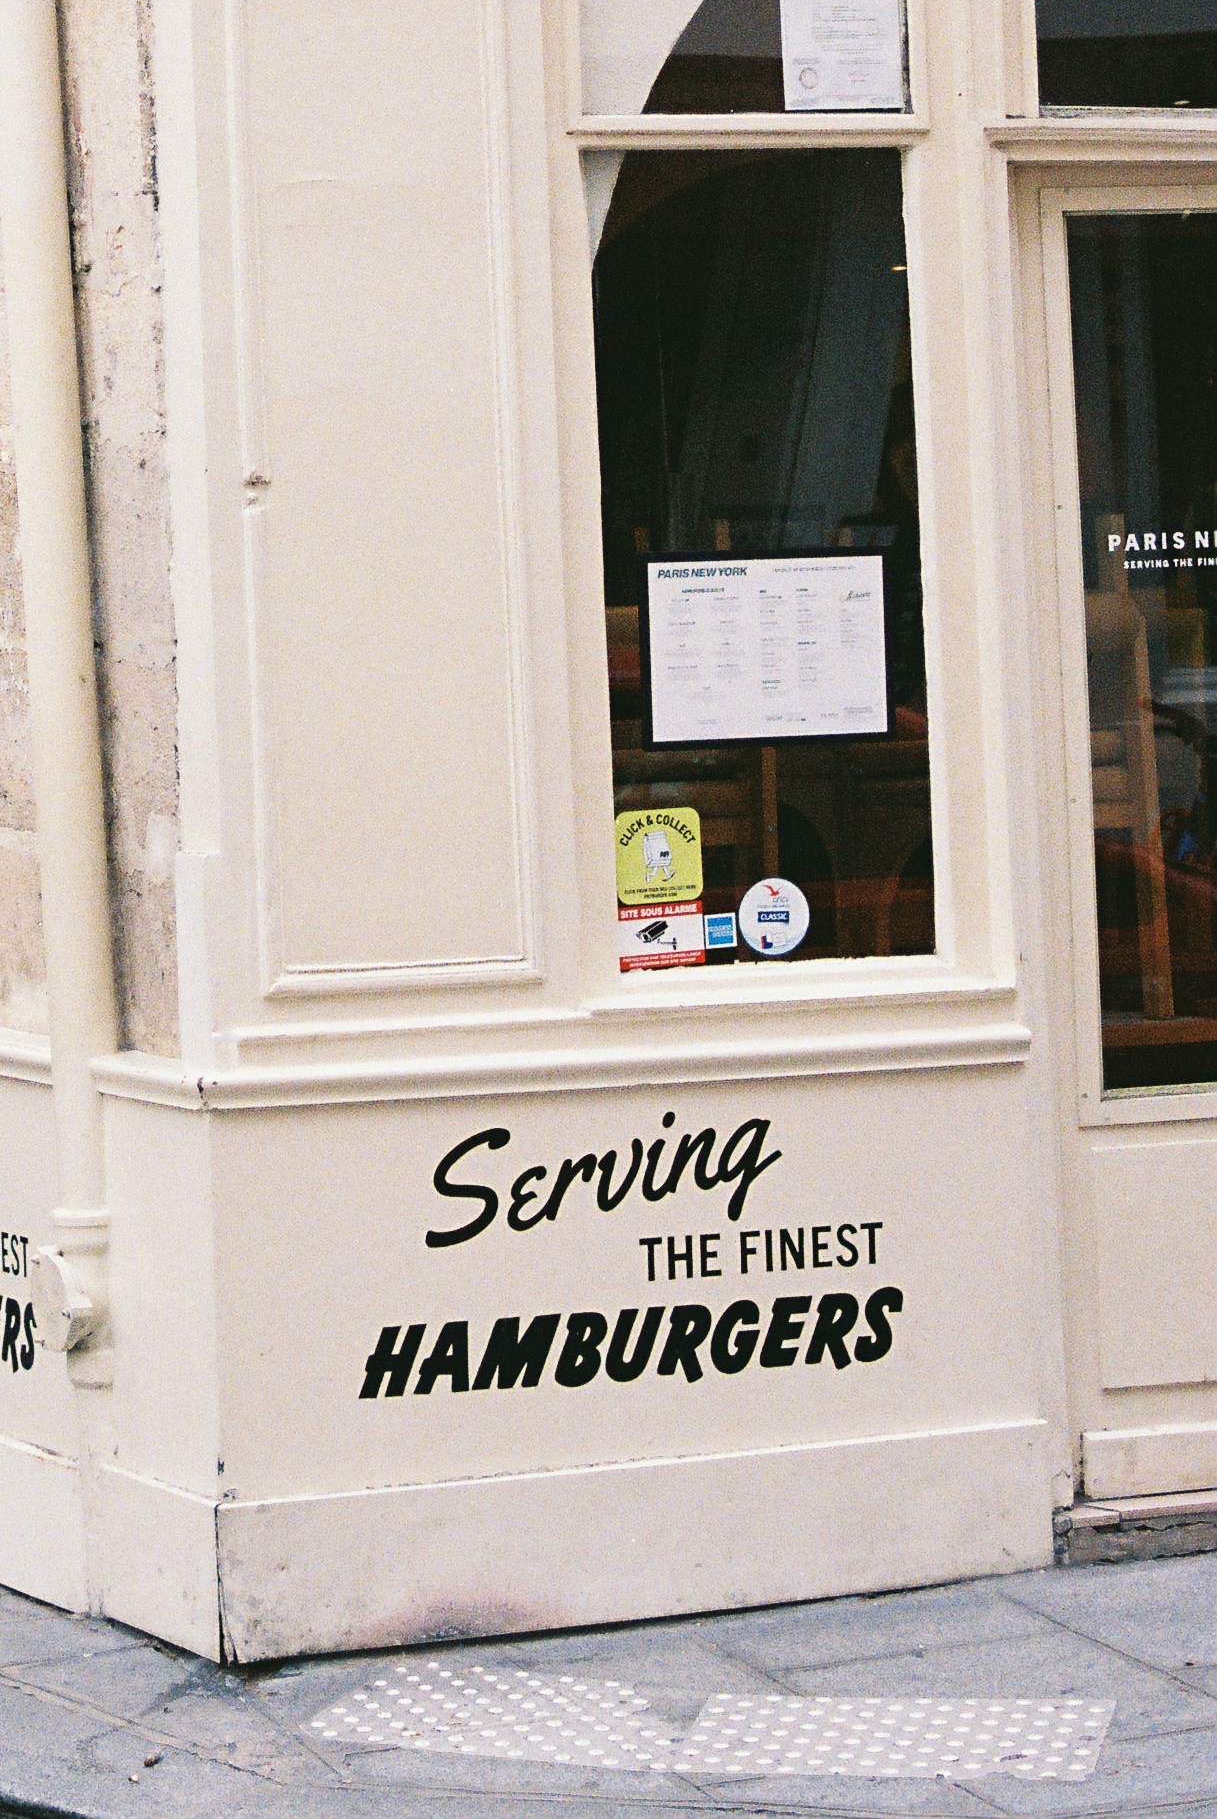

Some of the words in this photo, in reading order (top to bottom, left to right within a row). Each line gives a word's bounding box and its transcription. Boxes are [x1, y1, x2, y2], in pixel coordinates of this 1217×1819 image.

[1108, 532, 1186, 552] PARIS
[1194, 530, 1217, 549] N
[657, 568, 689, 579] PARIS
[691, 567, 717, 577] NEW
[718, 566, 748, 577] YORK
[1124, 559, 1169, 570] SERVING
[1173, 557, 1193, 568] THE
[1197, 557, 1217, 567] FIN
[619, 818, 645, 847] CLICK
[646, 815, 653, 826] &
[656, 813, 696, 844] COLLECT
[620, 909, 639, 919] SITE
[640, 907, 662, 917] SOUS
[665, 903, 698, 915] ALARME
[760, 912, 787, 921] CLASSIC
[425, 1111, 782, 1249] Serving
[639, 1232, 723, 1282] THE
[739, 1221, 884, 1275] FINEST
[358, 1286, 904, 1400] HAMBURGERS
